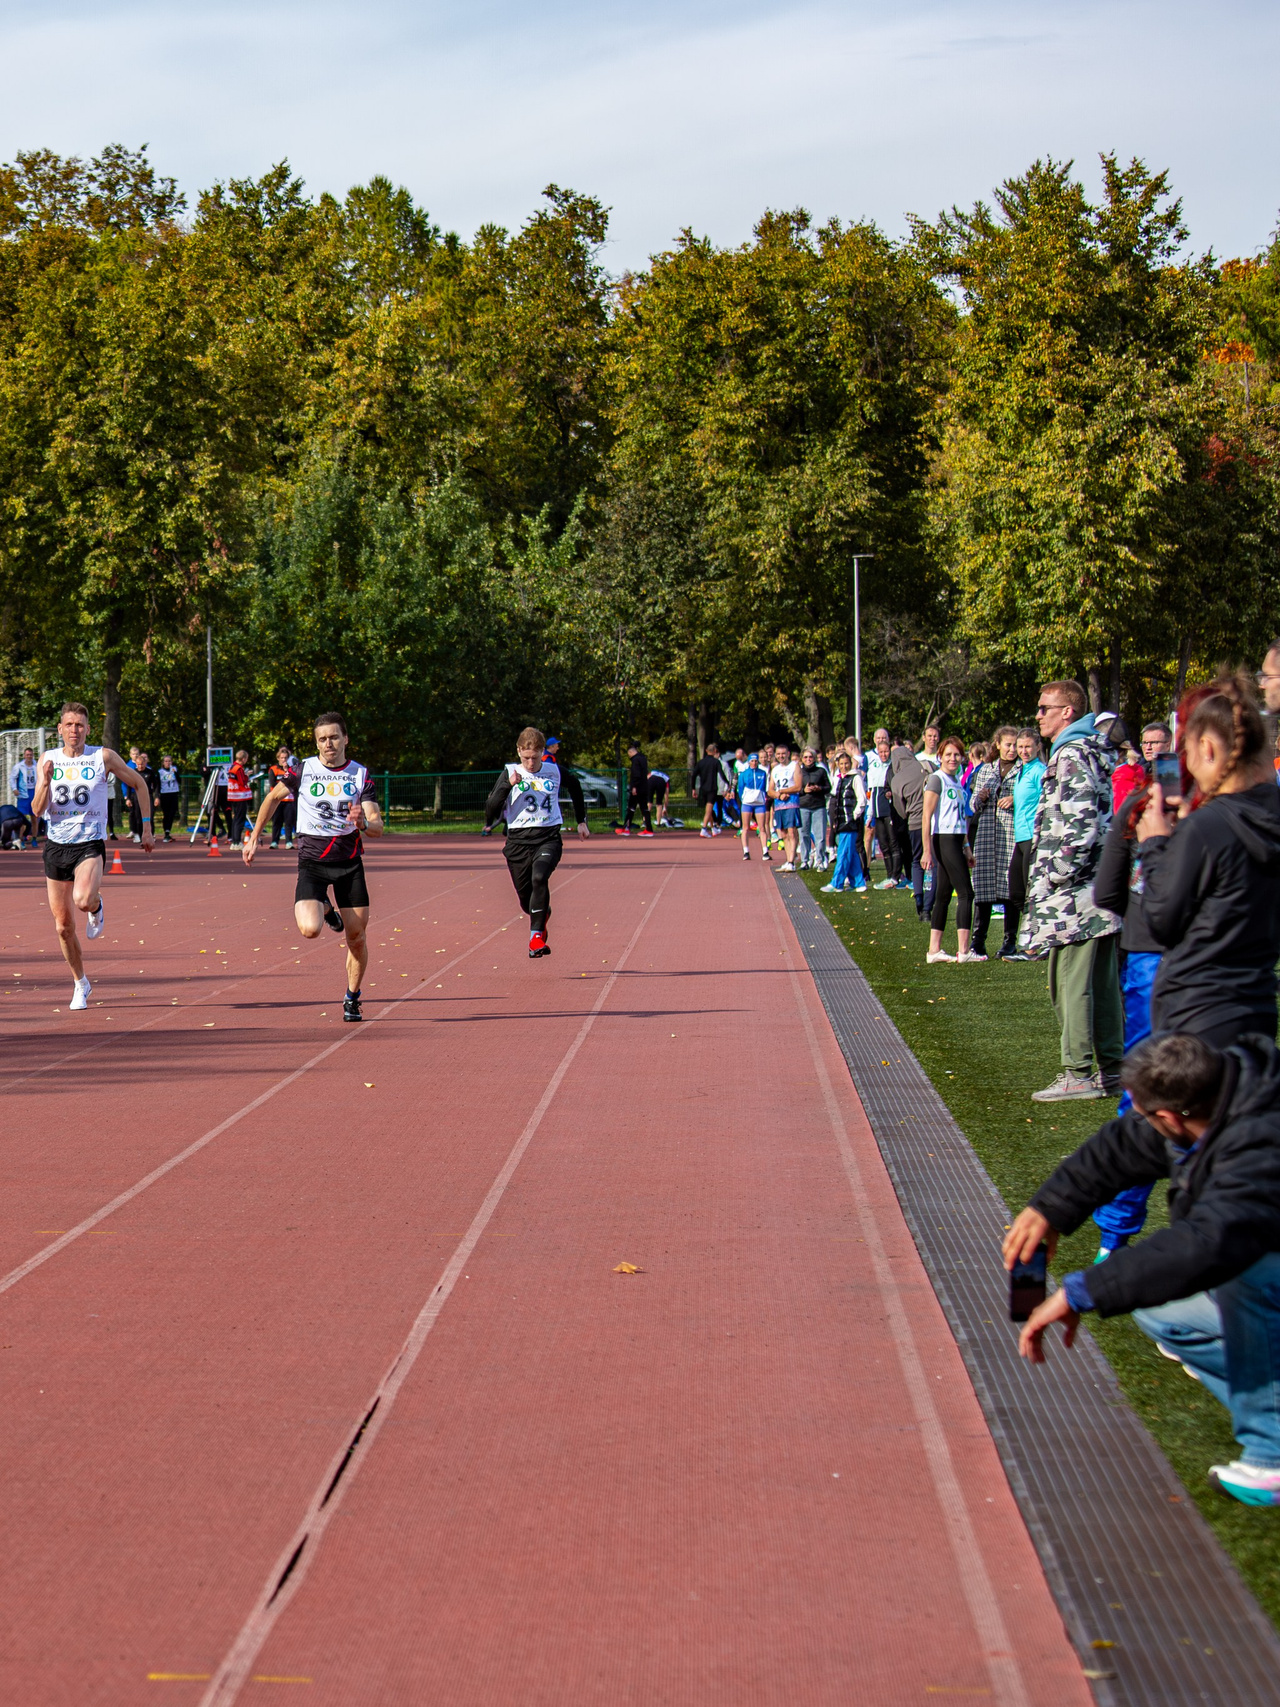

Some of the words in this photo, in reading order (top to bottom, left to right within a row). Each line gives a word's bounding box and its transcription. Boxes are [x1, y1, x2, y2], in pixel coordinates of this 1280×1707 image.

[310, 775, 357, 784] VMARAFONE
[55, 784, 91, 807] 36
[524, 794, 552, 813] 34
